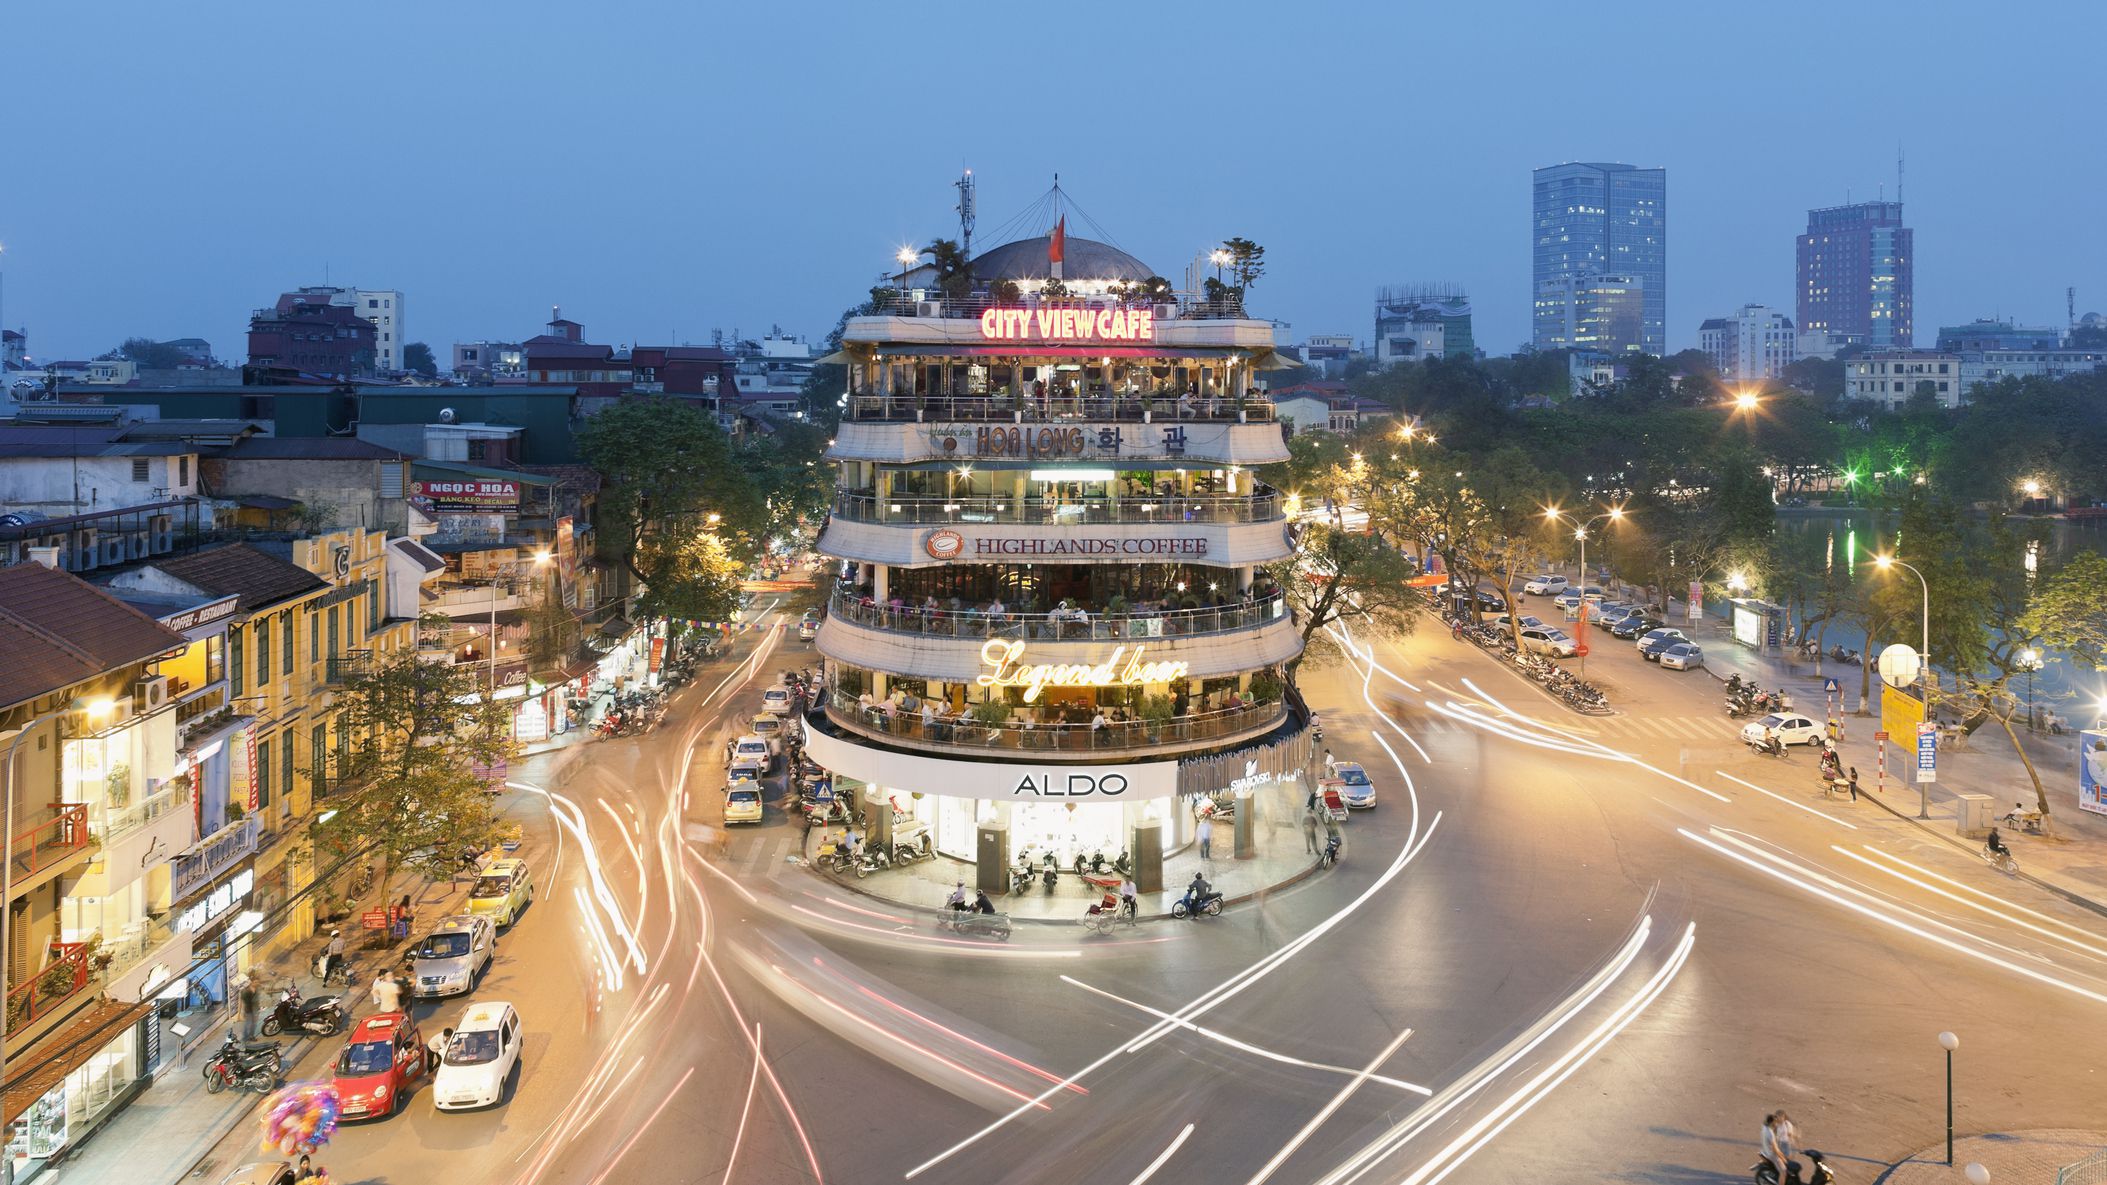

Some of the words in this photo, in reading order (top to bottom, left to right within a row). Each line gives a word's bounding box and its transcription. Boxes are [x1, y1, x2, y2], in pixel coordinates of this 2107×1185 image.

[981, 308, 1033, 339] CITY
[1036, 309, 1096, 339] VIEW
[1097, 309, 1153, 339] CAFE
[976, 426, 1021, 455] HOA
[1025, 426, 1085, 455] LONG
[1097, 426, 1124, 453] 화
[1161, 426, 1188, 454] 관
[430, 483, 475, 494] NGỌC
[481, 483, 515, 493] HOA
[930, 531, 961, 543] HIGHLANDS
[974, 538, 1117, 555] HIGHLANDS
[1121, 538, 1208, 555] COFFEE
[170, 612, 195, 632] COFFEE
[199, 599, 238, 623] RESTAURANT
[503, 671, 526, 685] Coffee
[976, 638, 1126, 703] Legend
[1121, 645, 1189, 685] beer
[1013, 773, 1129, 797] ALDO
